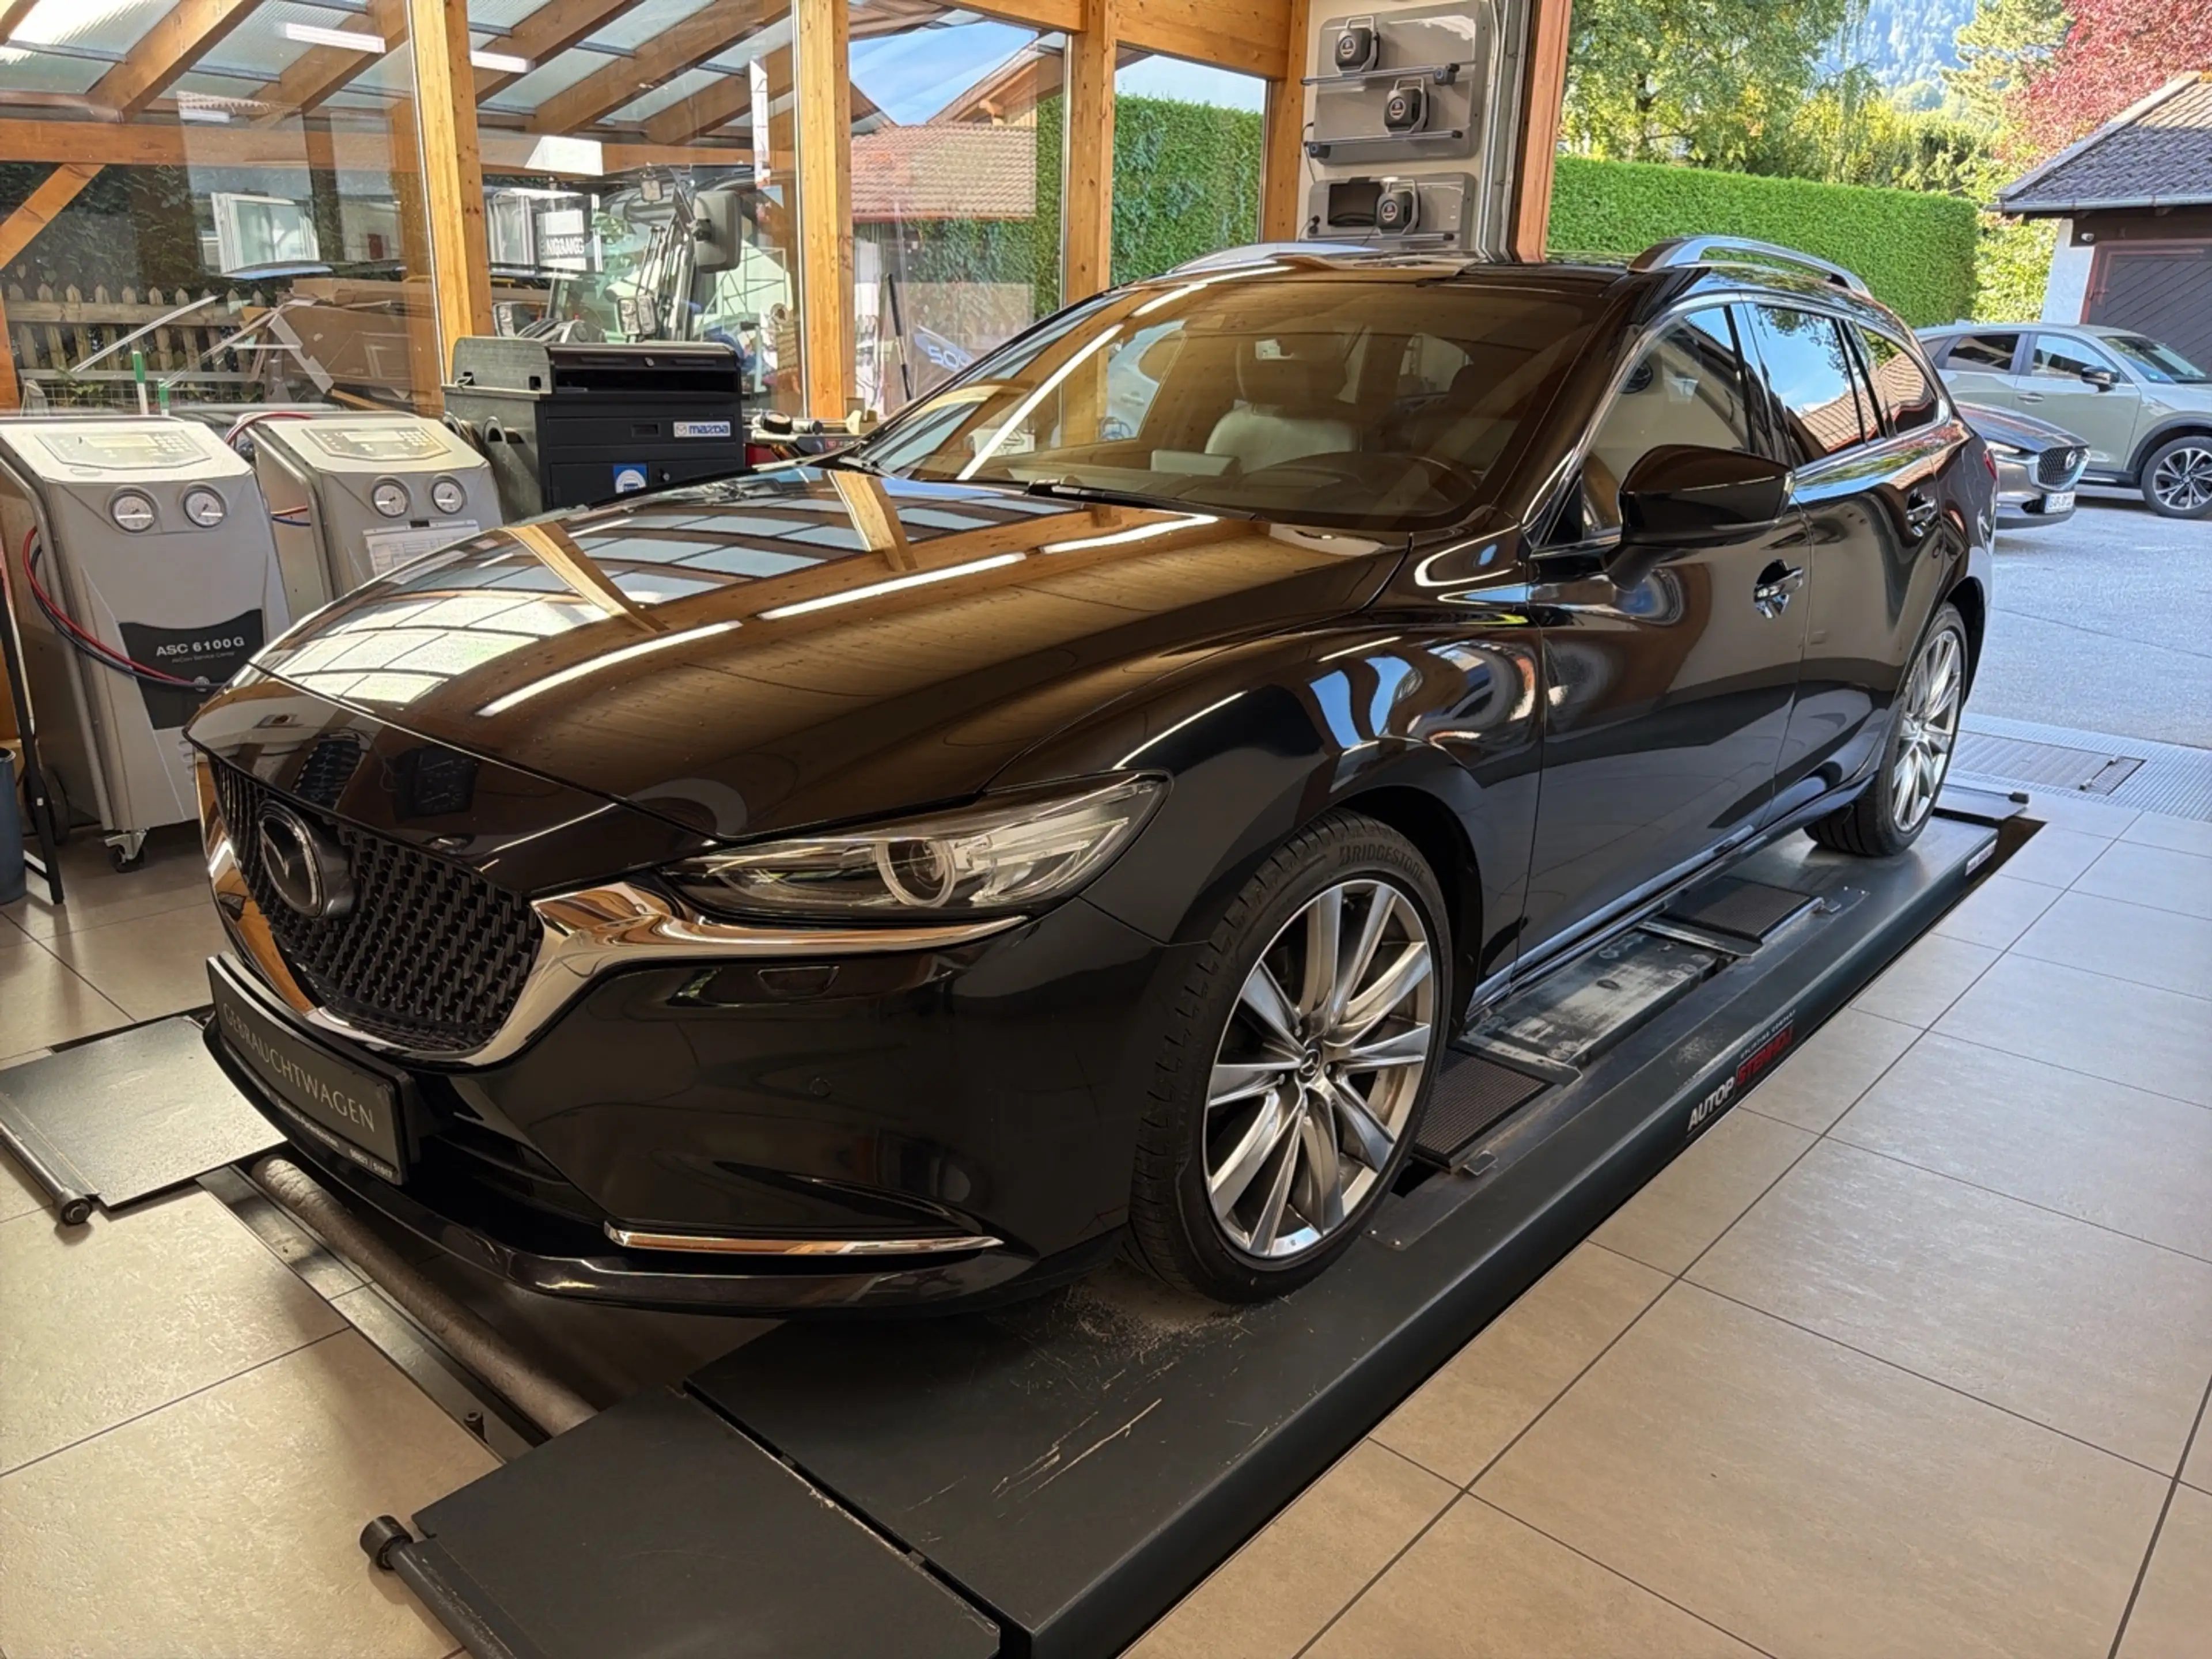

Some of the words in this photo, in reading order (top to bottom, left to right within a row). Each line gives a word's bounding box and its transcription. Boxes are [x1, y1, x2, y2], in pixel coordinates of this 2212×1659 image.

[156, 643, 188, 657] ASC
[192, 637, 245, 652] 6100G
[1338, 843, 1426, 884] BRIDGESTONE
[222, 1002, 375, 1133] GEBRAUCHTWAGEN
[1687, 1076, 1736, 1131] AUTOP
